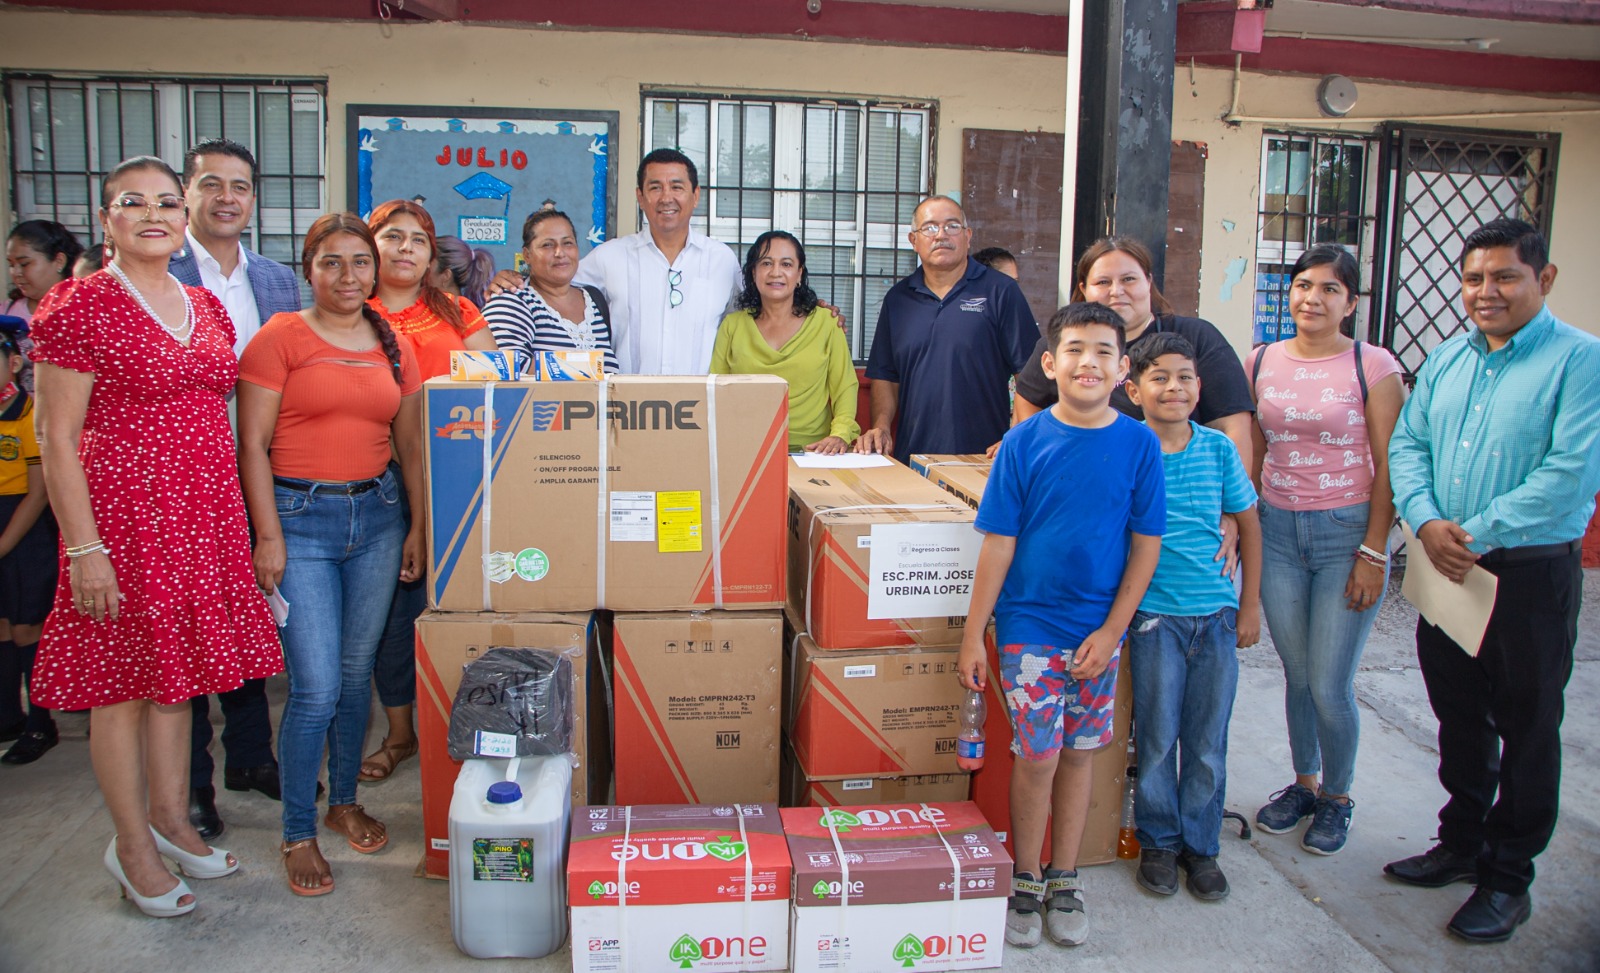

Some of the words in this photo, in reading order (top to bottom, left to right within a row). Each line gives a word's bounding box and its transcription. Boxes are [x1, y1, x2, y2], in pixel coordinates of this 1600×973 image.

[435, 145, 528, 170] JULIO
[467, 228, 501, 241] 2023
[1258, 304, 1275, 312] una
[1256, 315, 1275, 325] para
[1266, 325, 1275, 334] tu
[1293, 367, 1329, 381] Barbie
[1263, 386, 1298, 399] Barbie
[1320, 388, 1360, 403] Barbie
[563, 400, 702, 430] PRIME
[1284, 407, 1323, 422] Barbie
[1266, 429, 1298, 443] Barbie
[1319, 431, 1354, 445] Barbie
[1288, 450, 1324, 467] Barbie
[1271, 472, 1298, 487] Barbie
[1318, 473, 1354, 490] Barbie
[882, 570, 941, 582] ESC.PRIM.
[944, 569, 974, 580] JOSE
[885, 585, 931, 596] URBINA
[933, 584, 969, 595] LOPEZ
[698, 694, 756, 702] CMPRN242-T3
[909, 704, 960, 713] EMPRN242-T3
[716, 734, 740, 747] NOM
[935, 739, 957, 752] NOM
[589, 812, 609, 820] 70
[968, 846, 990, 854] 70
[809, 855, 831, 863] LS
[680, 943, 697, 955] IK
[903, 943, 919, 954] IK
